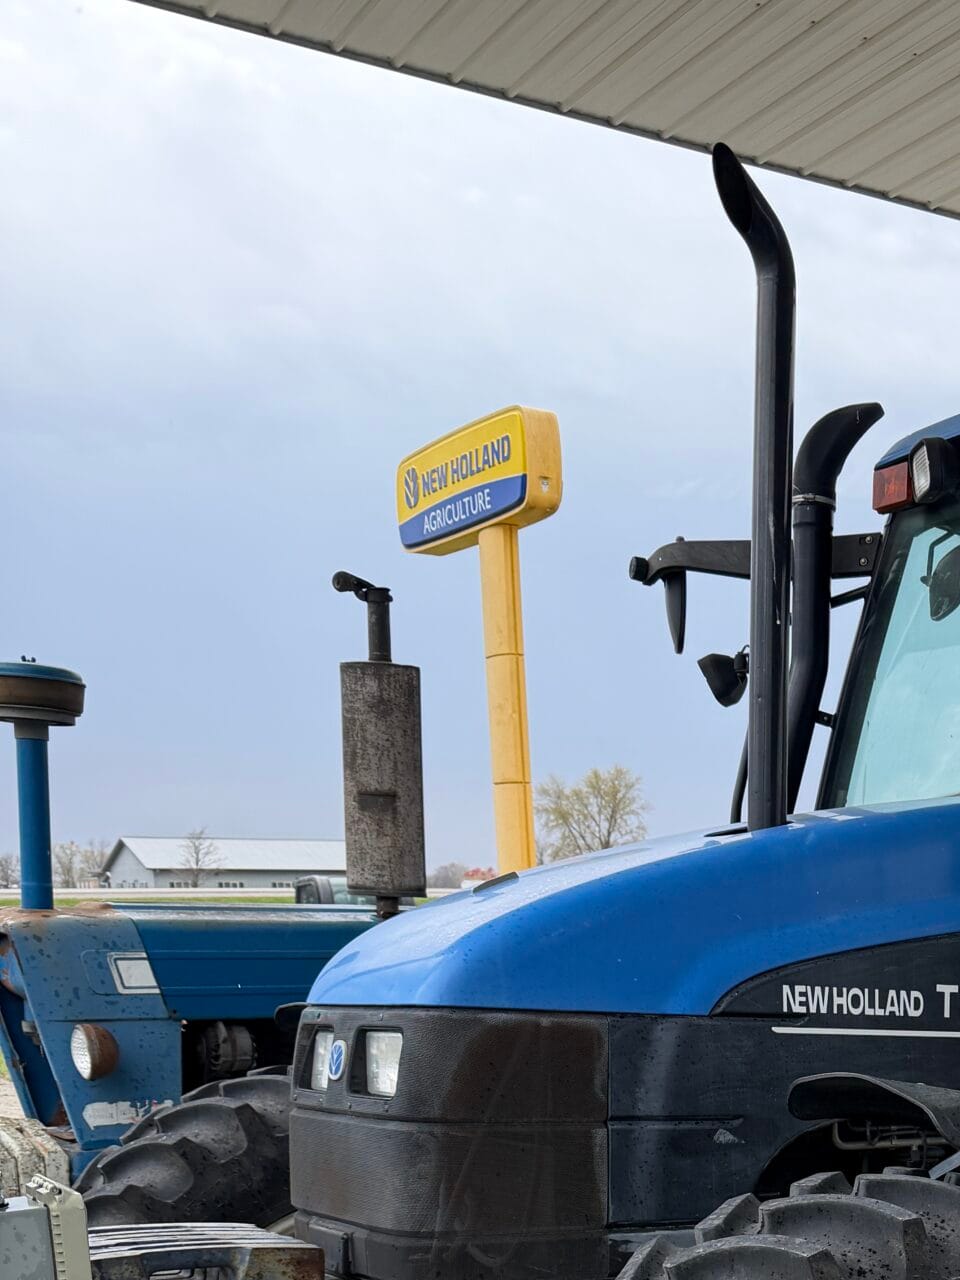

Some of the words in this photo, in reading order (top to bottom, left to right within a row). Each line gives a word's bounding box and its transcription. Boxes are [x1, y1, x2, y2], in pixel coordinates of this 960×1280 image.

[421, 461, 449, 498] NEW
[450, 434, 511, 485] HOLLAND
[422, 488, 492, 534] AGRICULTURE
[781, 984, 829, 1015] NEW
[832, 986, 925, 1018] HOLLAND
